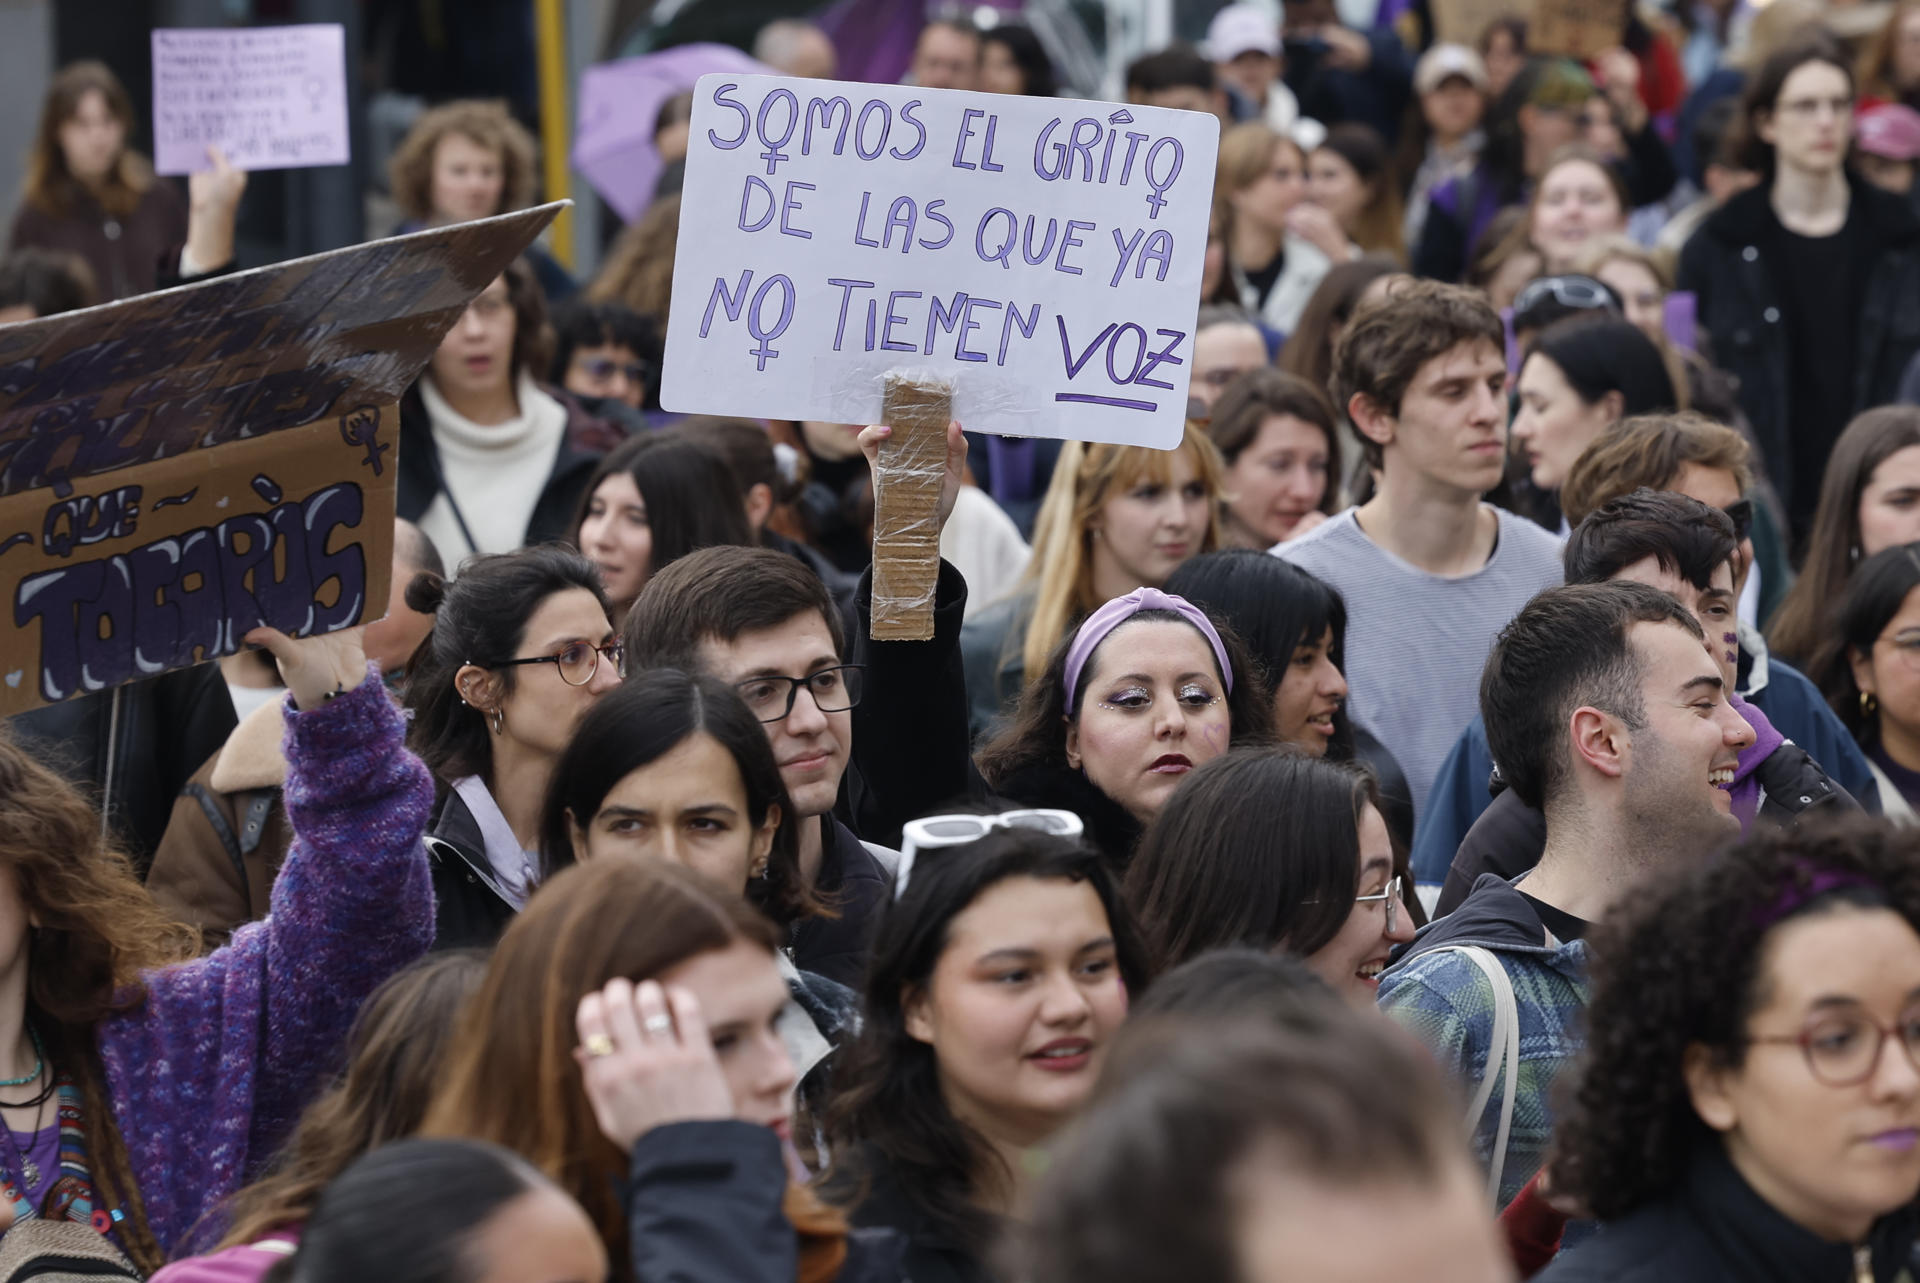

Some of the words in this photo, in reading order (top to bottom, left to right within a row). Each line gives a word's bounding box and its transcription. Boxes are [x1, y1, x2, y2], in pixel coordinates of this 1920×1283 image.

[708, 84, 926, 175] SOMOS
[952, 108, 1004, 172] EL
[738, 175, 816, 239] DE
[855, 192, 955, 253] LAS
[976, 207, 1096, 275] QUE
[1110, 228, 1174, 287] YA
[699, 270, 796, 371] NO
[828, 279, 1041, 366] TIENEN
[1056, 315, 1187, 390] VOZ
[43, 485, 142, 556] QUE
